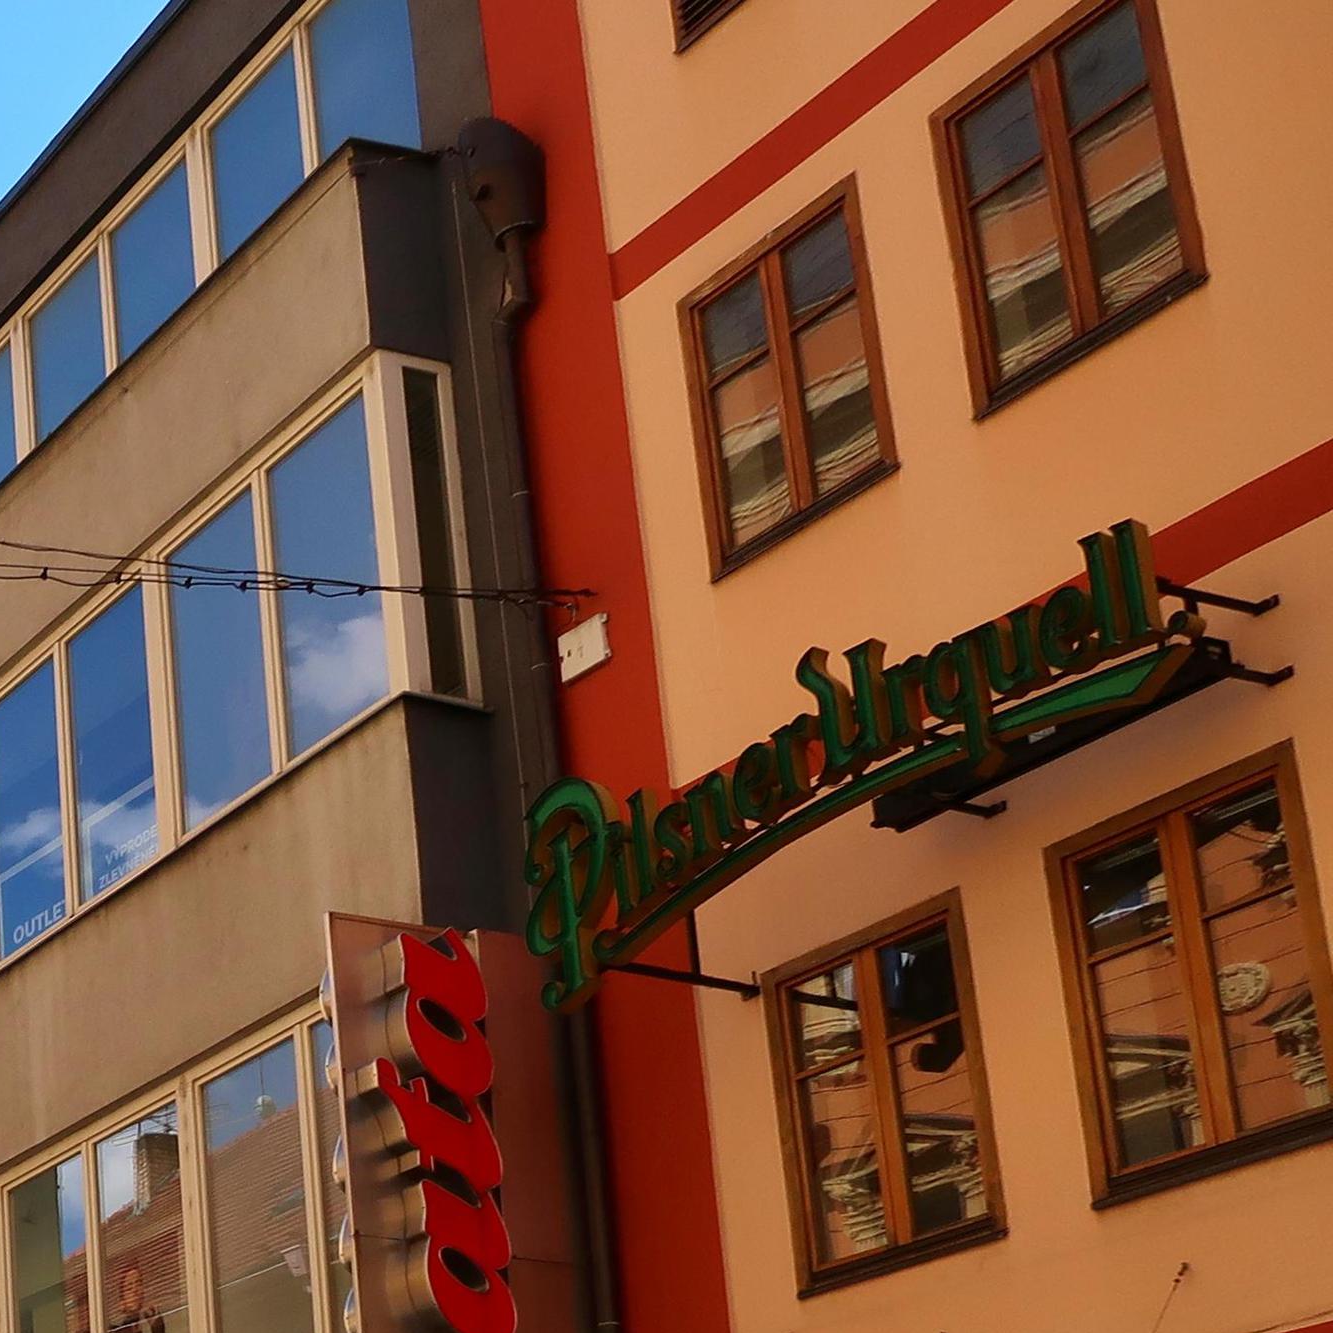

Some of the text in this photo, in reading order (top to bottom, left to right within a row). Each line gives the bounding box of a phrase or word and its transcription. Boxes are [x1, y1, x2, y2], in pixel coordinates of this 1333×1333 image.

[525, 518, 1171, 1012] Pilsner Urquell
[13, 900, 65, 944] OUTLE
